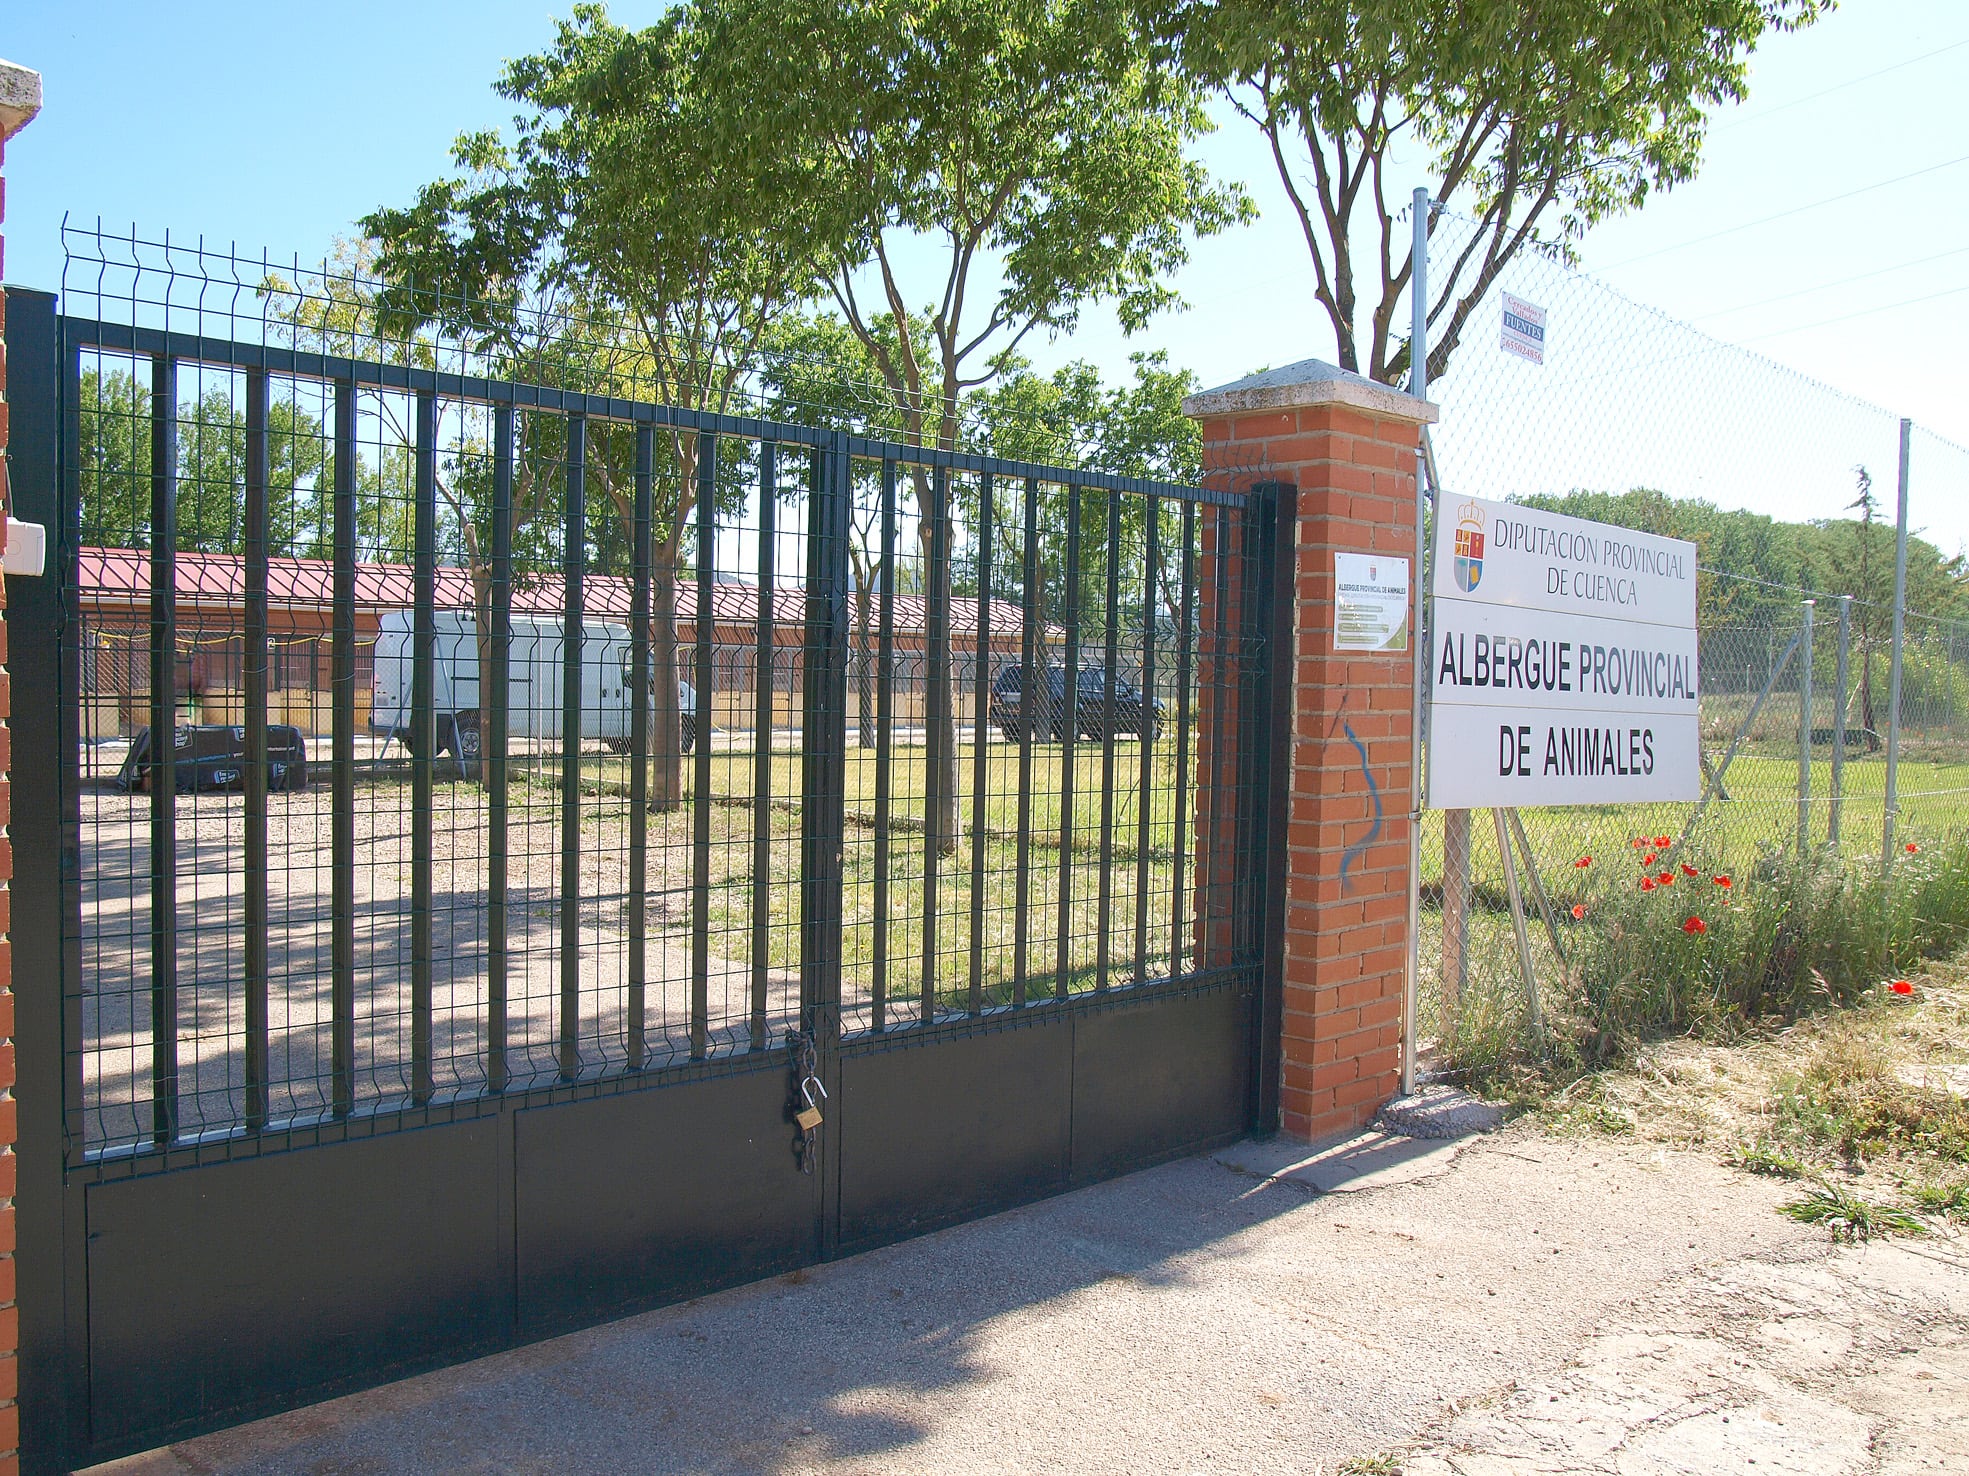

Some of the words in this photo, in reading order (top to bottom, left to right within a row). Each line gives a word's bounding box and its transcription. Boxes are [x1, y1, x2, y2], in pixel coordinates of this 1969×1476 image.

[1506, 313, 1541, 339] FUENTES
[1505, 339, 1542, 362] 655024856
[1494, 519, 1598, 564] DIPUTACIÓN
[1603, 540, 1685, 580] PROVINCIAL
[1338, 583, 1360, 592] ALBERGUE
[1360, 584, 1382, 593] PROVINCIAL
[1387, 586, 1406, 595] ANIMALES
[1547, 567, 1569, 596] DE
[1573, 571, 1638, 606] CUENCA
[1439, 631, 1571, 691] ALBERGUE
[1579, 644, 1695, 700] PROVINCIAL
[1499, 725, 1531, 777] DE
[1543, 726, 1654, 776] ANIMALES
